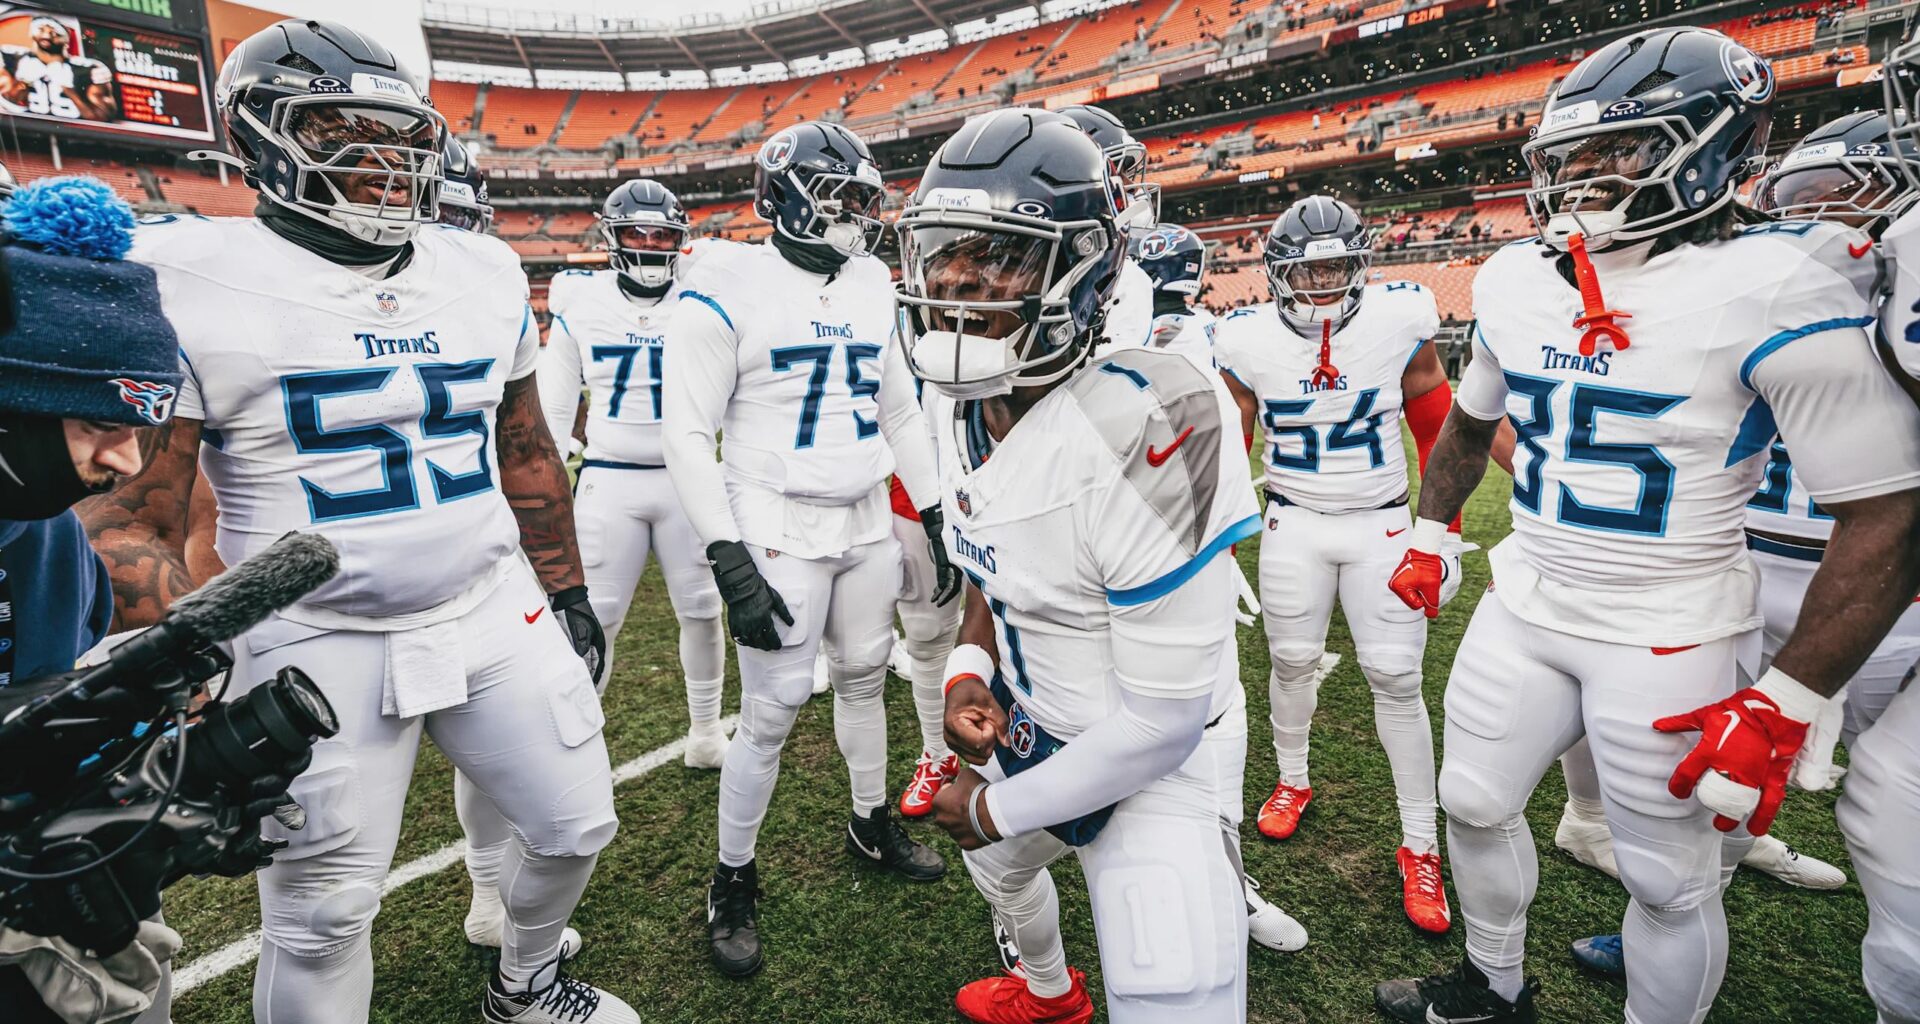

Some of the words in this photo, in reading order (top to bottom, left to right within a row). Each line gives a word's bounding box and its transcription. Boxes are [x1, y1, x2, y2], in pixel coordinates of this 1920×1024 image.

[369, 76, 406, 95] TITANS
[1550, 108, 1580, 127] TITANS
[1603, 108, 1643, 118] OAKLEY
[1797, 146, 1829, 160] TITANS
[937, 194, 971, 207] TITANS
[625, 332, 665, 345] TITANS
[809, 320, 853, 339] TITANS
[353, 331, 440, 359] TITANS
[1541, 345, 1613, 376] TITANS
[770, 342, 883, 450] 75
[279, 357, 496, 521] 55
[1263, 388, 1385, 474] 54
[1503, 368, 1691, 538] 85
[952, 524, 997, 575] TITANS
